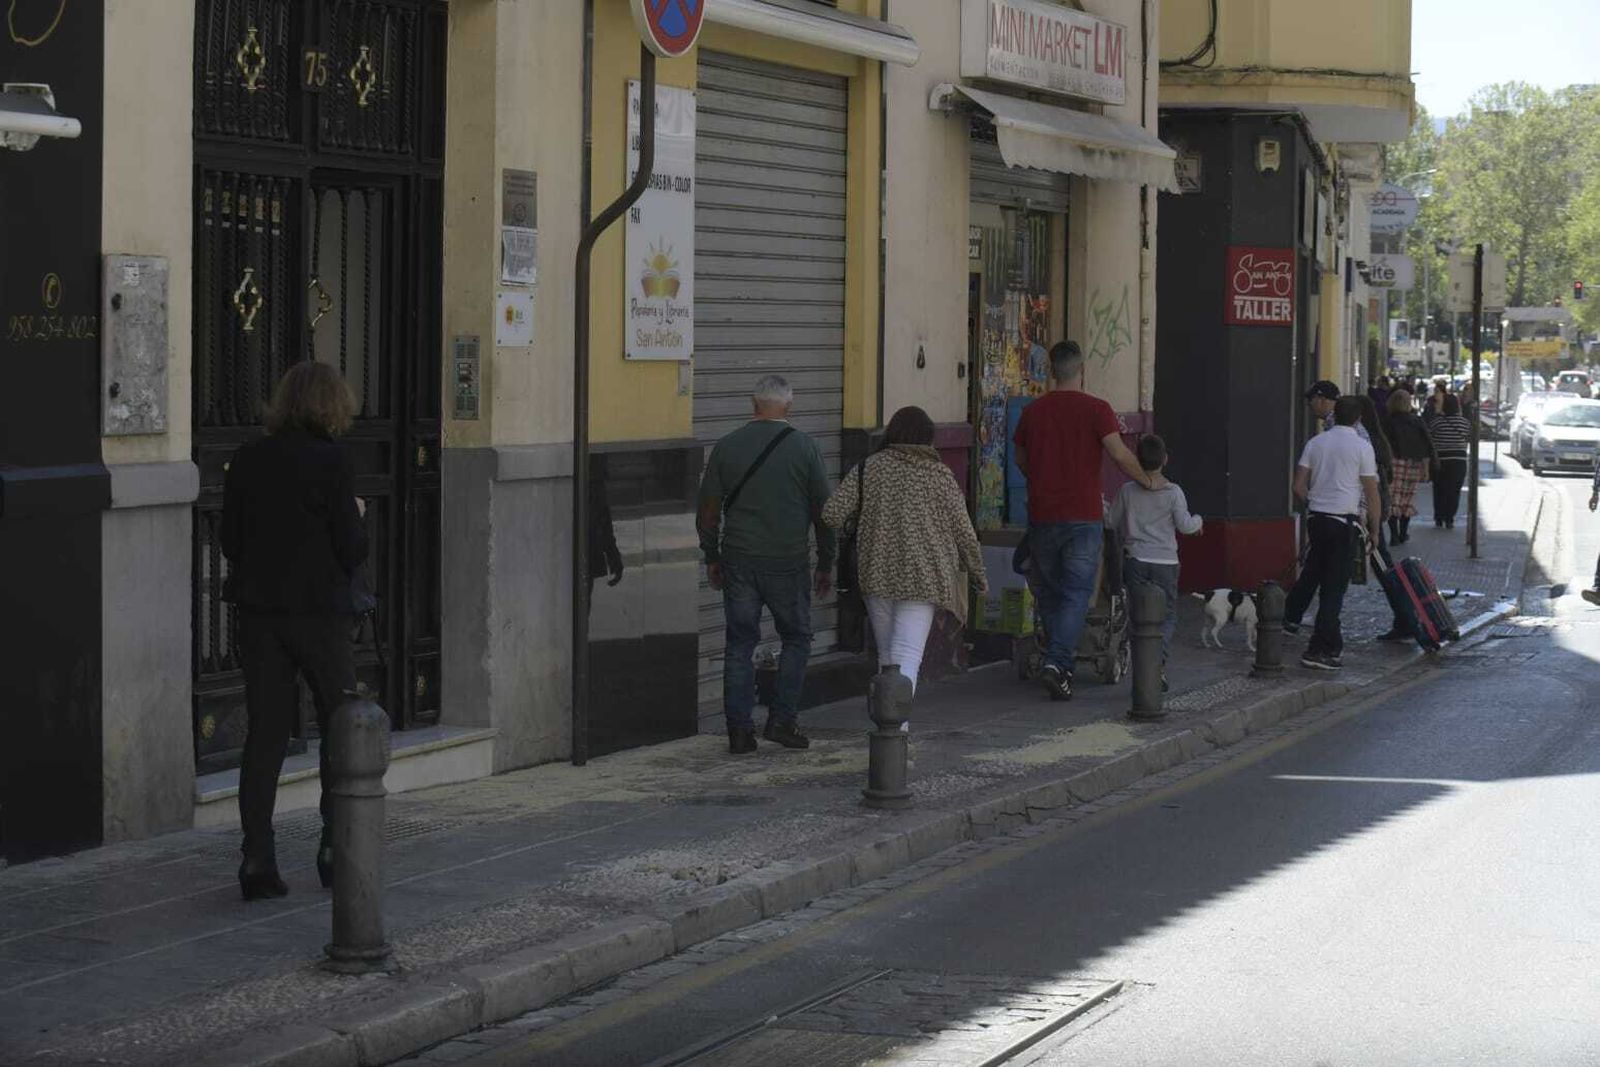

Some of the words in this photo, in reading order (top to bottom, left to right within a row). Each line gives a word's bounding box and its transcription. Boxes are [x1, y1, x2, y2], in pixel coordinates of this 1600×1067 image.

[991, 2, 1026, 56] MINI
[1029, 13, 1092, 70] MARKET
[1094, 21, 1122, 78] LM
[305, 51, 327, 86] 75
[630, 206, 641, 224] FAX
[1233, 299, 1292, 321] TALLER
